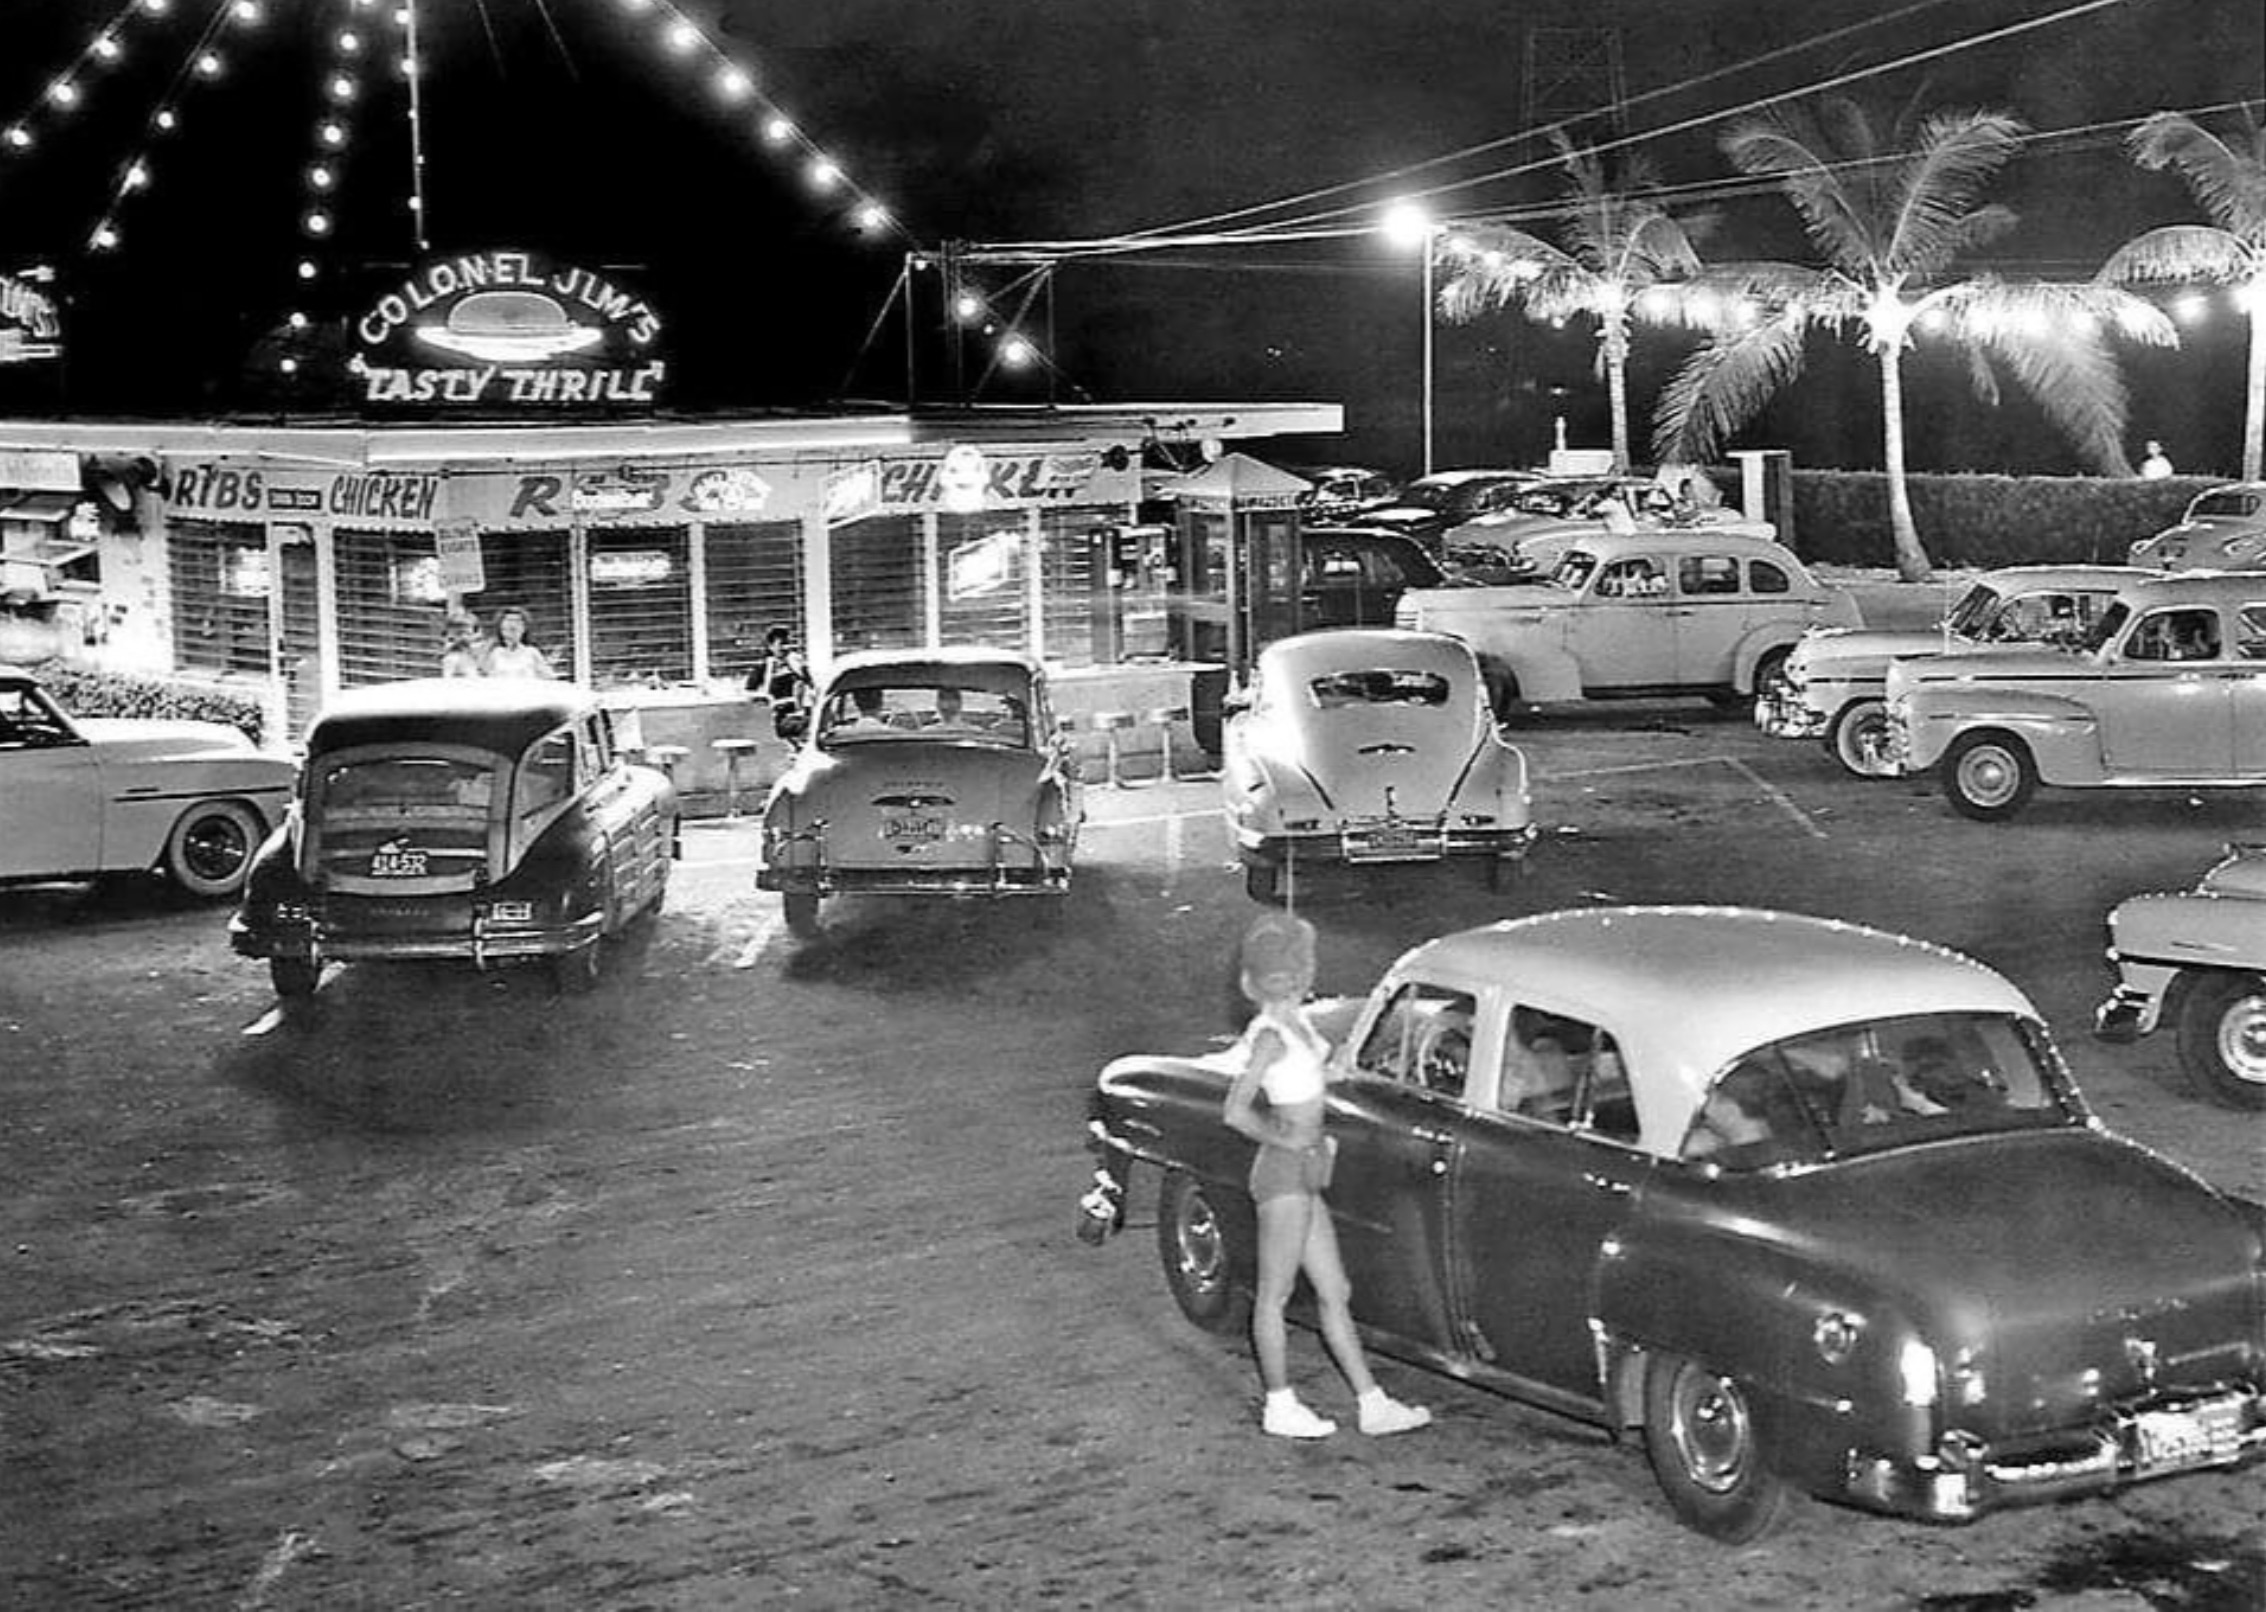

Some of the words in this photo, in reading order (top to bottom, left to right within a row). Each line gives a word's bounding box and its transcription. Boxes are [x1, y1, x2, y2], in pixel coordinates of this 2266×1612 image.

[359, 252, 546, 345] COLONEL
[175, 466, 264, 510] RIBS
[329, 475, 438, 520] CHICKEN
